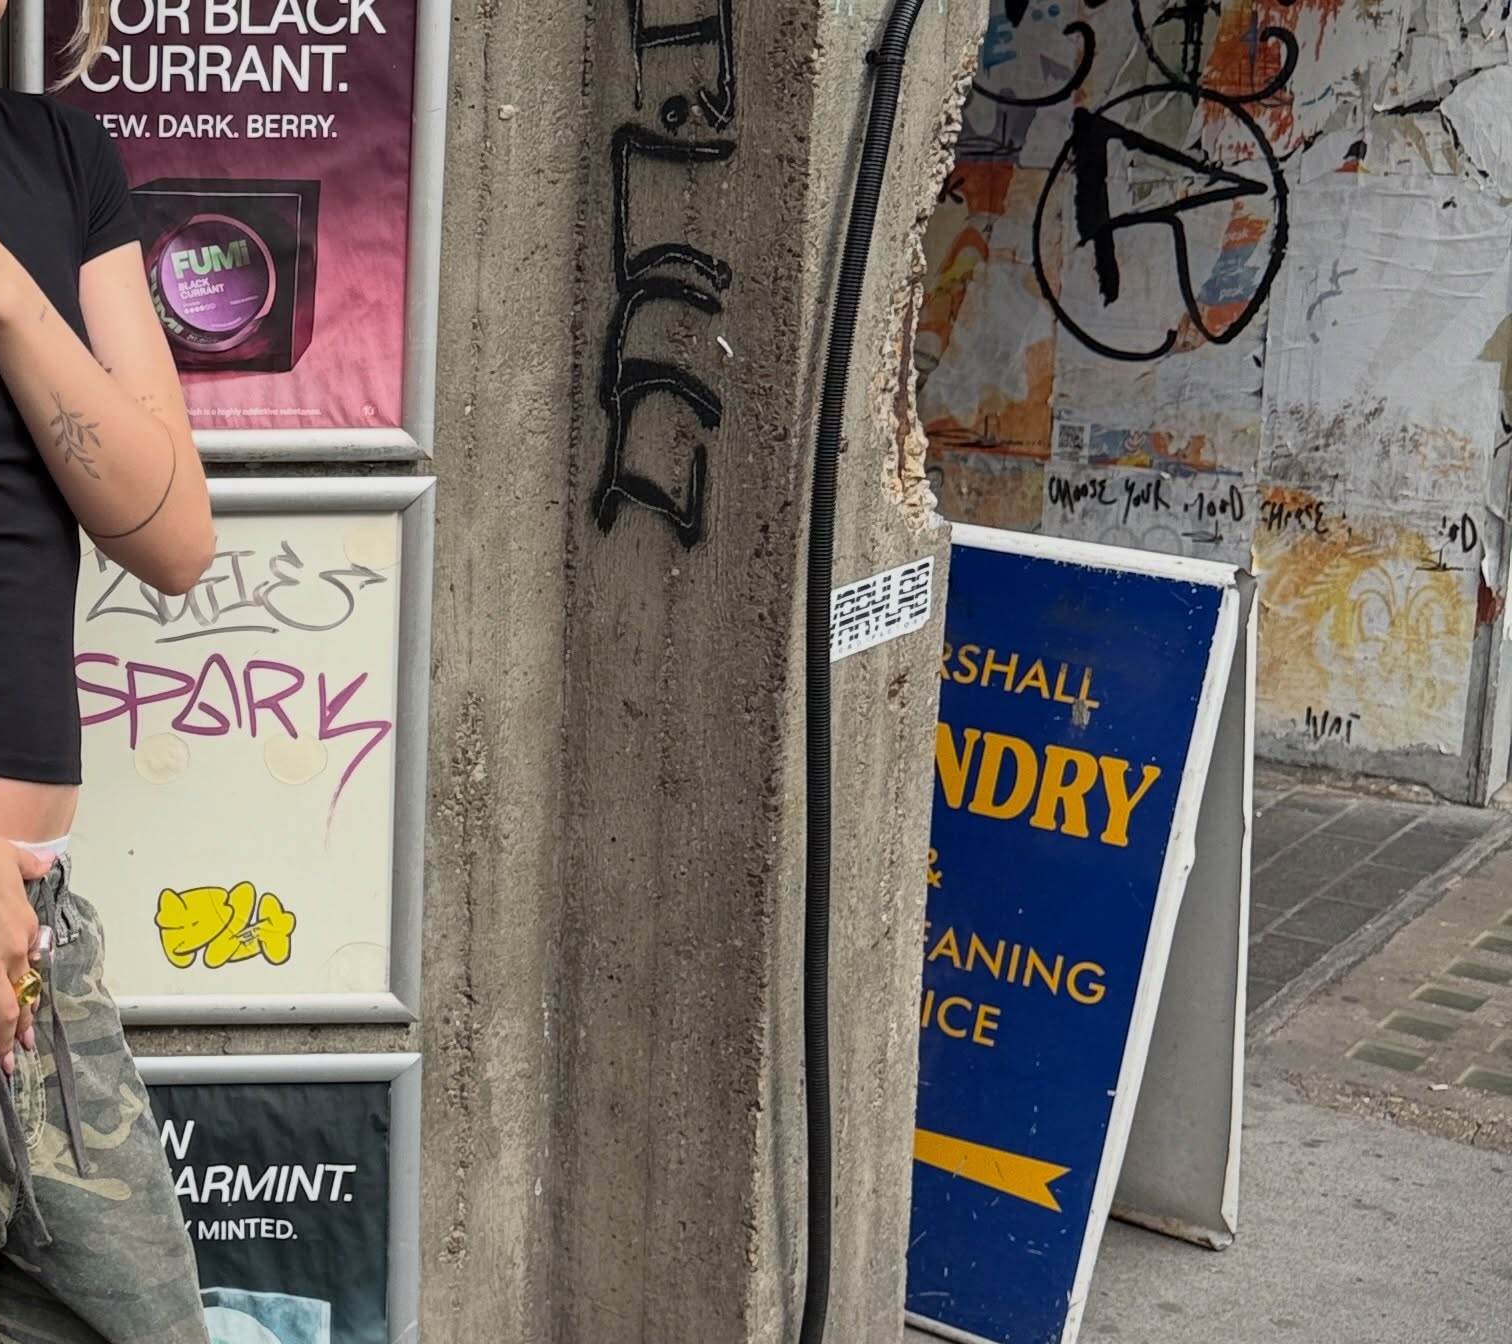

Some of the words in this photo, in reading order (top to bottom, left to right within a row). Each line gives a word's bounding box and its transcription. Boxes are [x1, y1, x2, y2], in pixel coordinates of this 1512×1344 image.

[79, 43, 349, 93] CURRANT.
[96, 113, 152, 139] EW.
[157, 113, 240, 139] DARK.
[245, 112, 338, 139] BERRY.
[170, 238, 253, 281] FUMi
[178, 277, 210, 292] BLACK
[180, 283, 226, 301] CURRANT
[934, 720, 1162, 848] NDRY
[924, 922, 1108, 1005] ANING
[172, 1163, 358, 1205] ARMINT.
[197, 1217, 300, 1241] MINTED.
